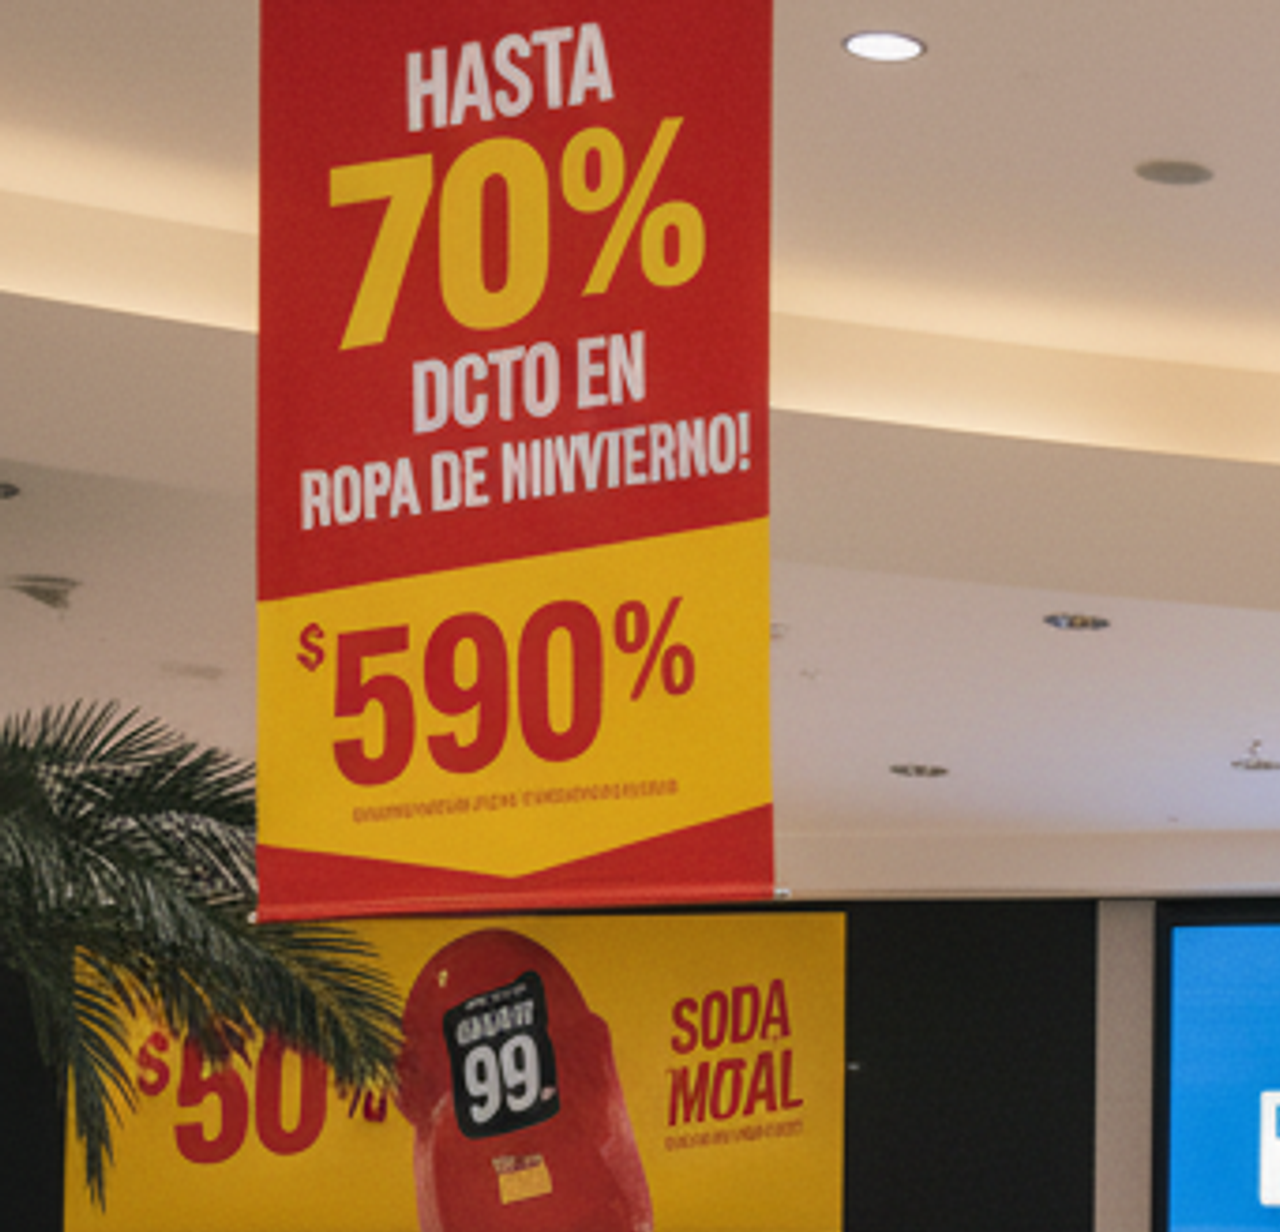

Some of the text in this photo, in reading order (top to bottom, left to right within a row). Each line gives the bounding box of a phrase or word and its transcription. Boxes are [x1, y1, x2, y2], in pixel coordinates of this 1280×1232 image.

[406, 22, 614, 132] HASTA
[329, 116, 706, 351] 70%
[412, 330, 646, 434] DCTO EN
[301, 458, 421, 530] ROPA
[431, 447, 490, 512] DE
[671, 978, 791, 1054] SODA
